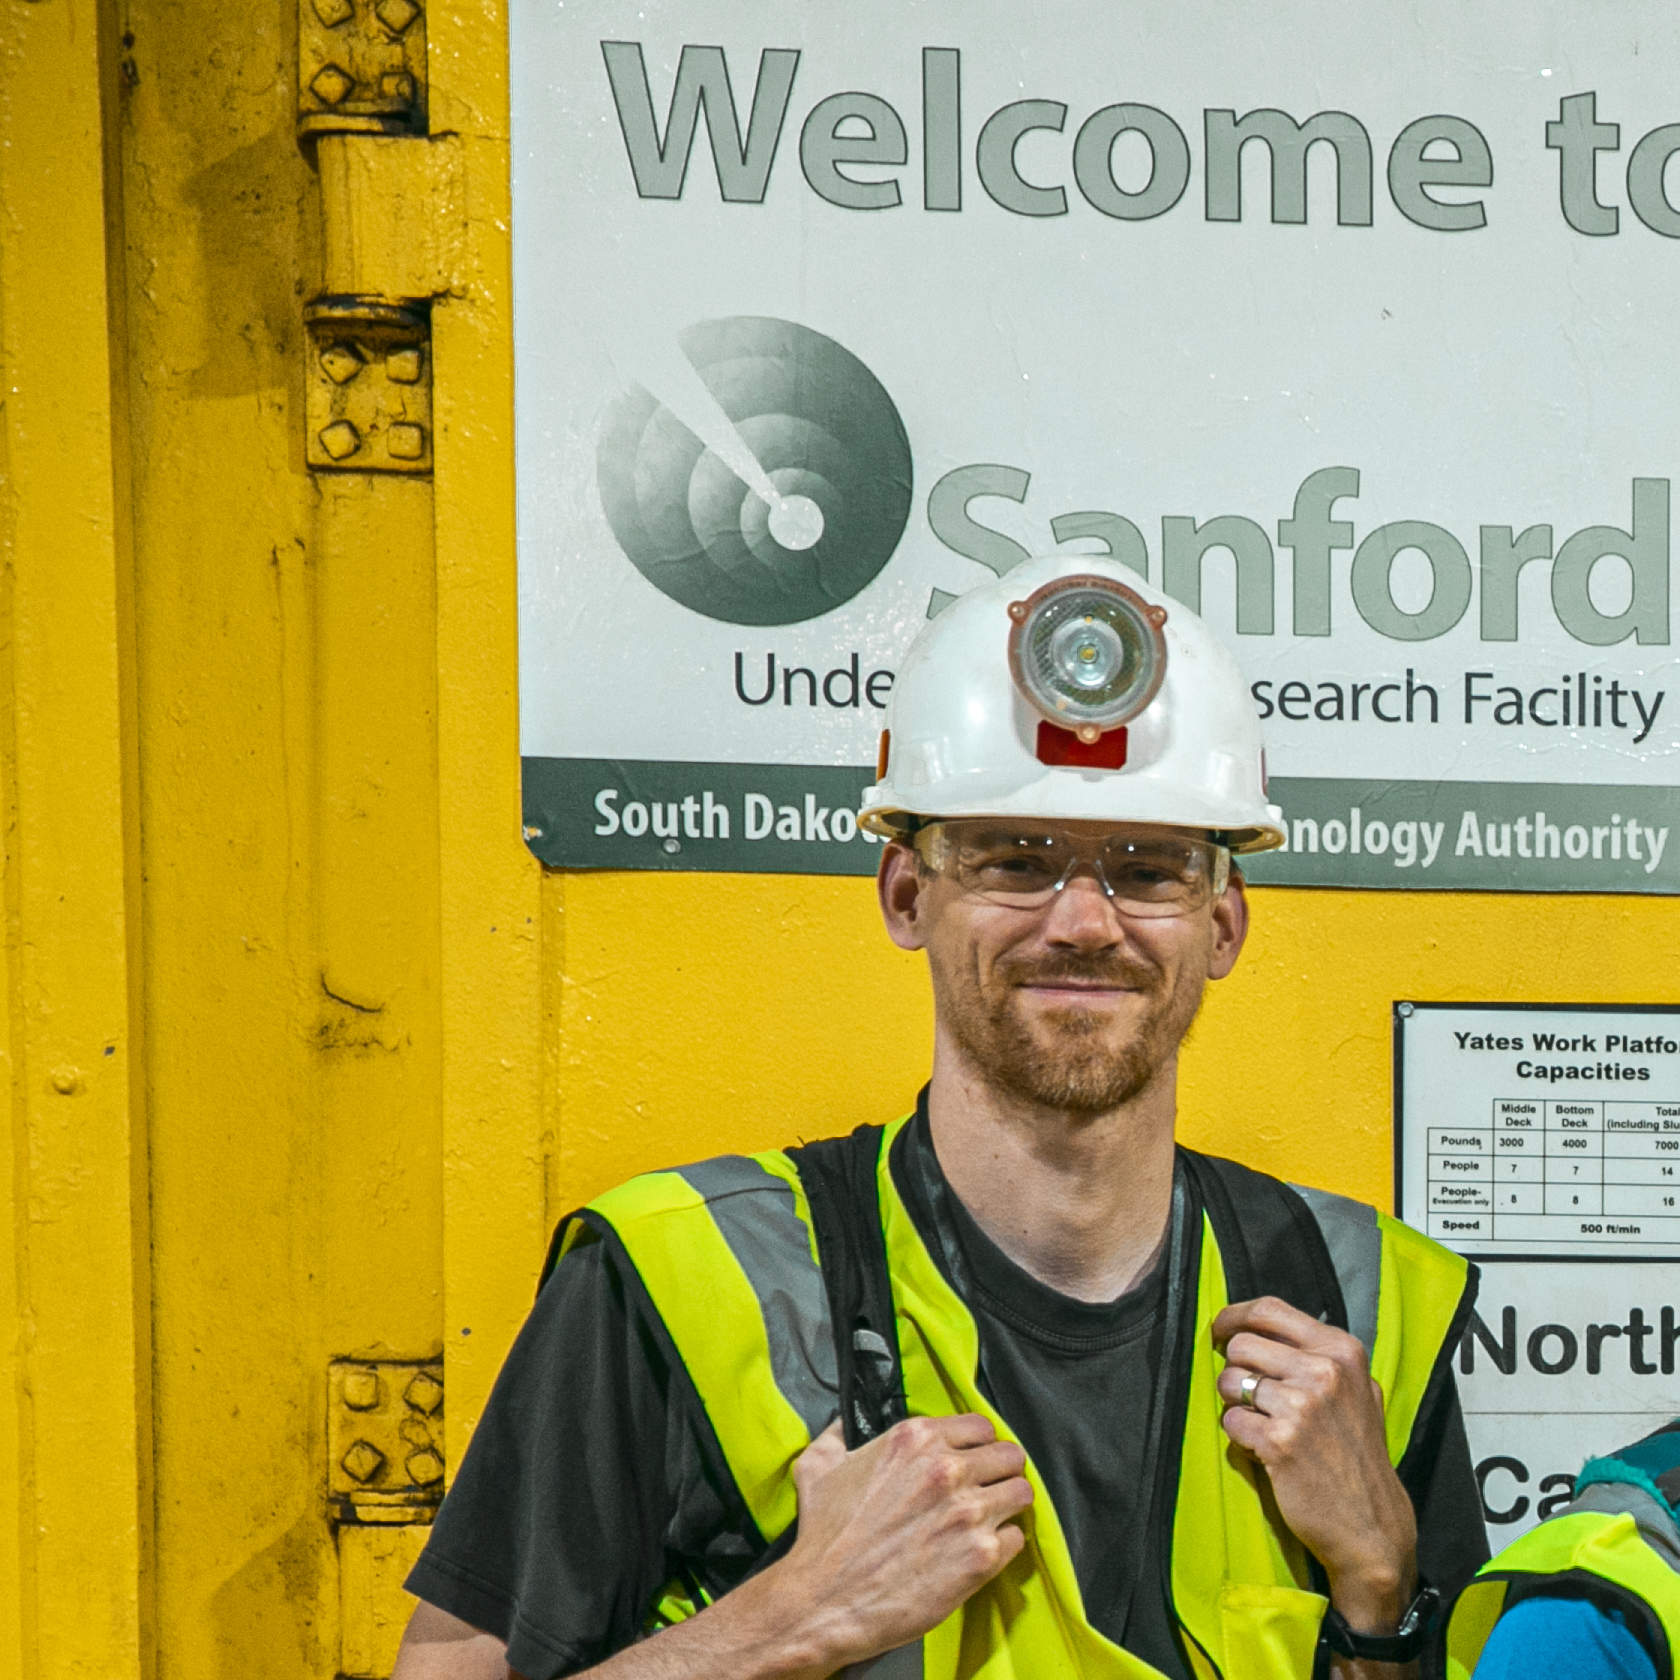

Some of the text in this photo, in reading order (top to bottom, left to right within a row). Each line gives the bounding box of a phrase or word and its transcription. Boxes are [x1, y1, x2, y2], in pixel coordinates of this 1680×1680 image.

[600, 39, 1495, 233] Welcome
[1251, 668, 1439, 723] search
[1464, 671, 1666, 744] Facility
[594, 788, 1669, 873] South Dako nology Authority
[1453, 1031, 1524, 1051] Yates
[1532, 1033, 1597, 1052] Work
[1516, 1060, 1651, 1083] Capacities
[1501, 1103, 1680, 1117] Middle Bottom Total
[1505, 1116, 1532, 1127] Deck
[1561, 1118, 1588, 1128] Deck
[1606, 1119, 1660, 1132] (including
[1499, 1137, 1524, 1147] 3000
[1562, 1138, 1588, 1149] 4000
[1655, 1140, 1680, 1150] 7000
[1442, 1160, 1674, 1176] People 7 7 14
[1510, 1194, 1675, 1207] 8 8 16
[1442, 1220, 1480, 1232] Speed
[1580, 1223, 1641, 1235] 500 ft/min
[1474, 1455, 1578, 1524] Ca
